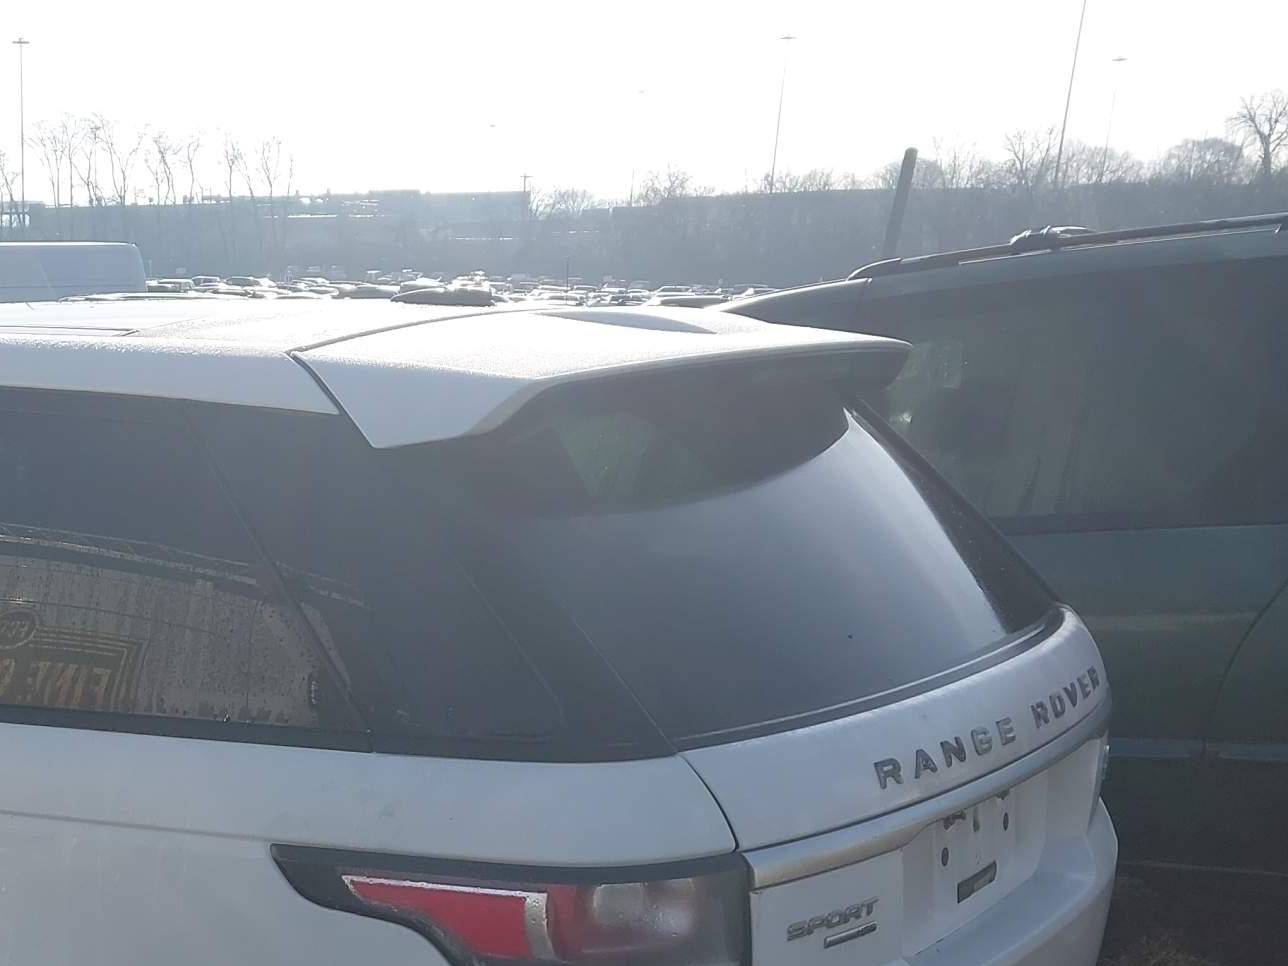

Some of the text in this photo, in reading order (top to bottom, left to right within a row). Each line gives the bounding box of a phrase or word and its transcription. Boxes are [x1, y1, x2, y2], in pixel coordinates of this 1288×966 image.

[874, 666, 1100, 789] RANGE ROVER
[786, 896, 880, 942] SPORT
